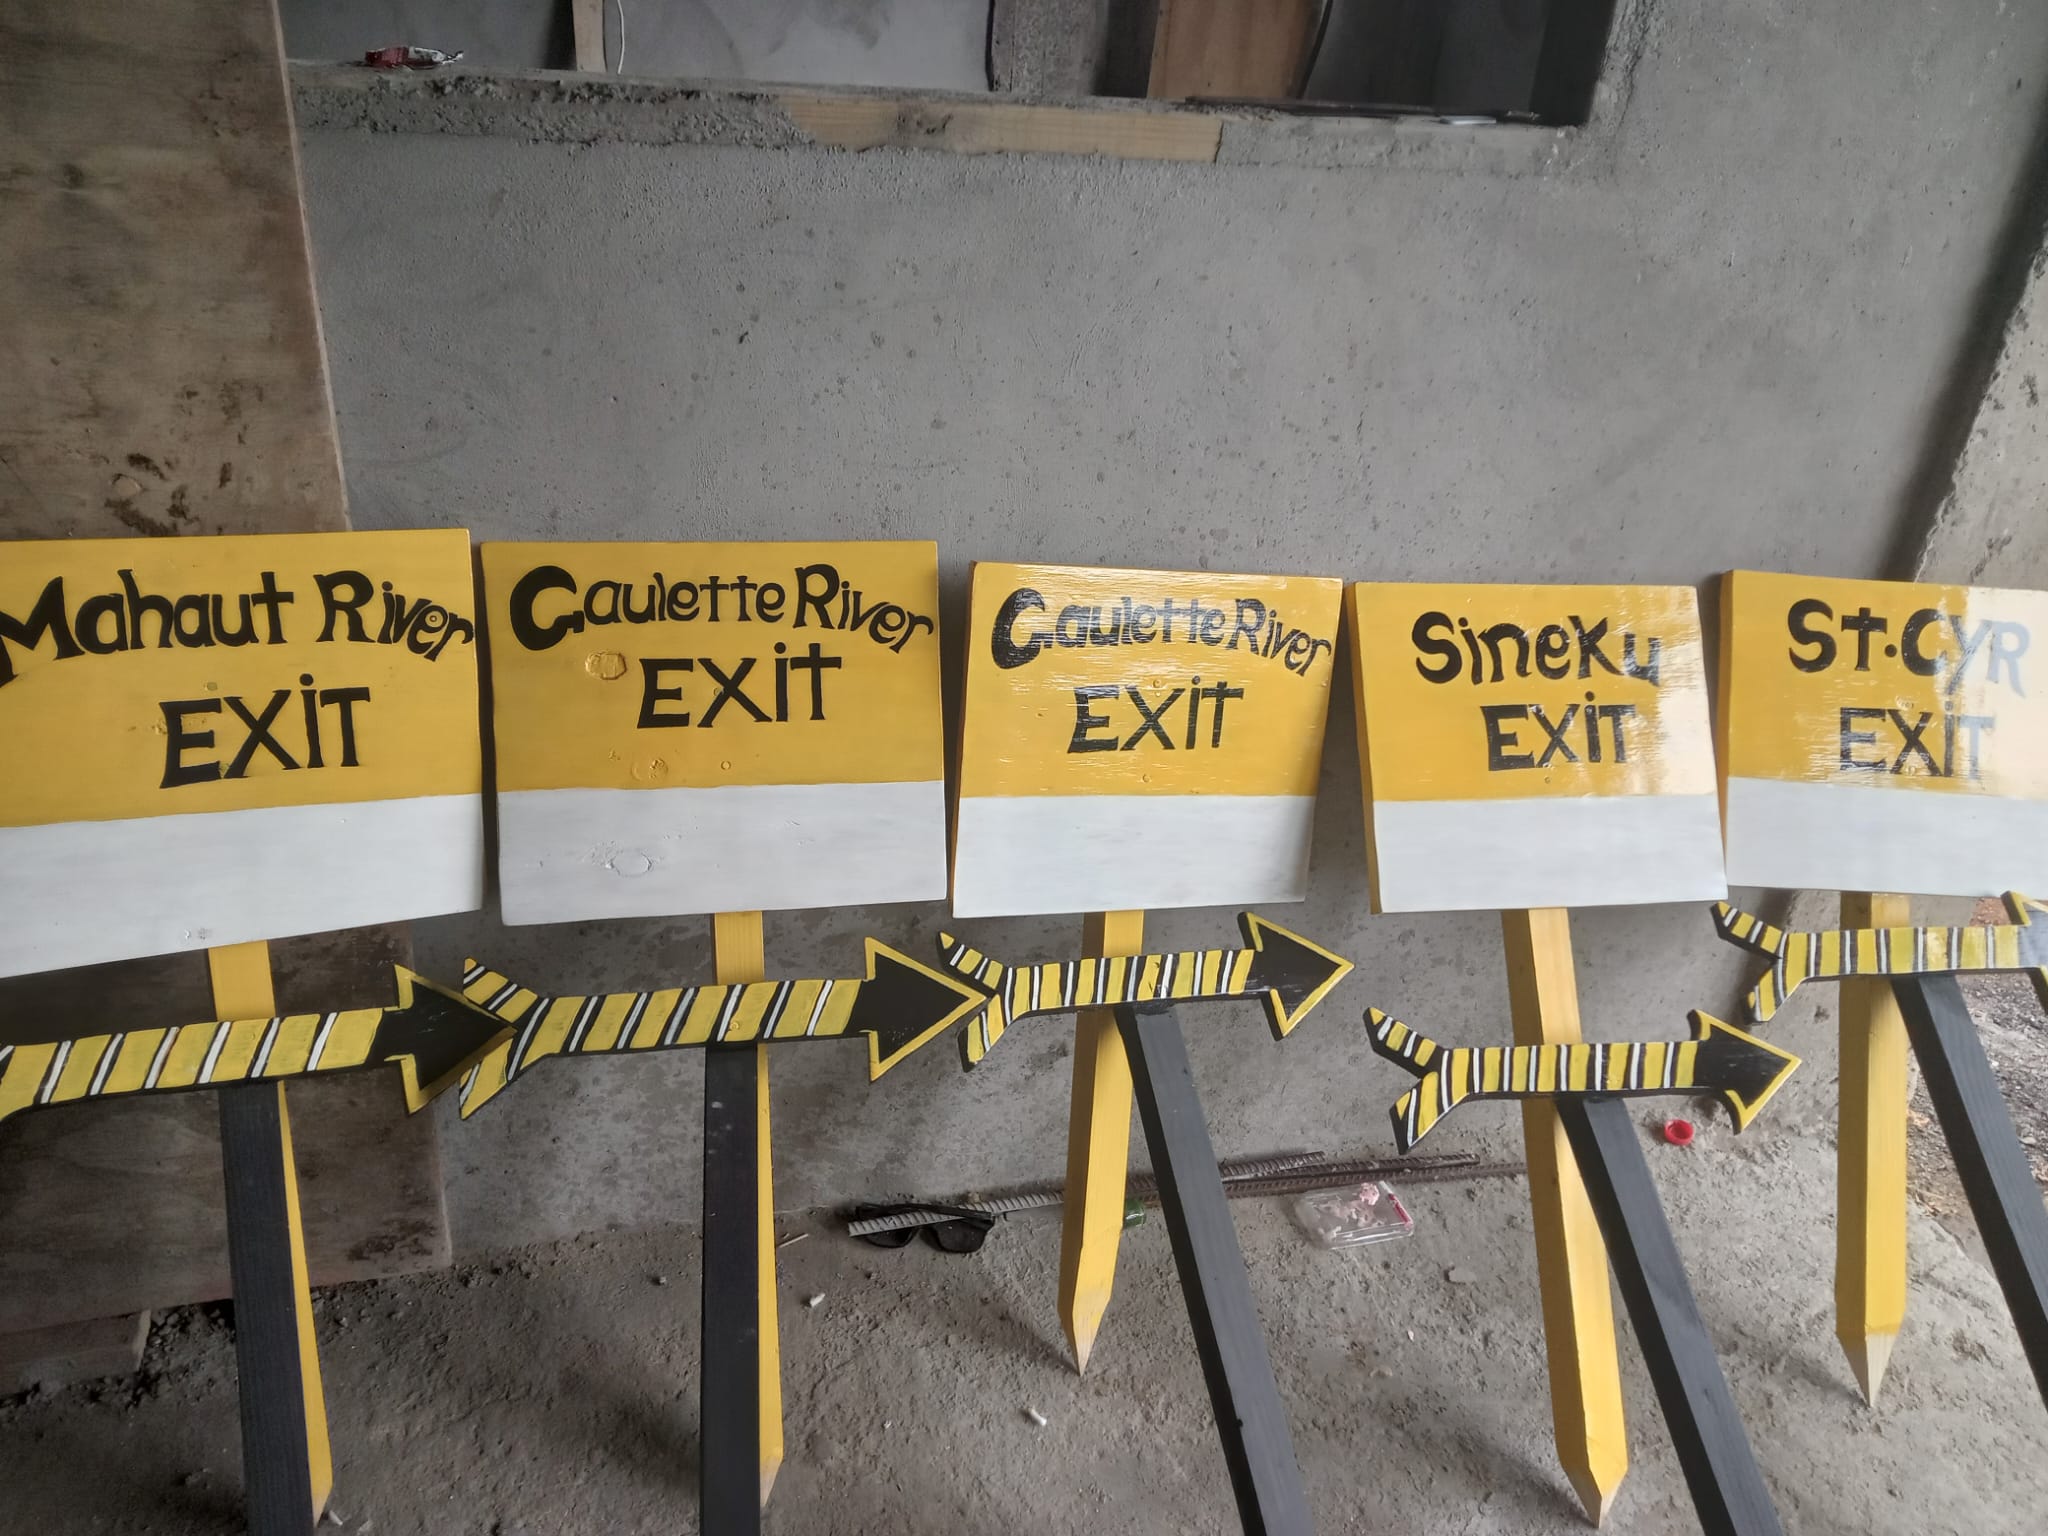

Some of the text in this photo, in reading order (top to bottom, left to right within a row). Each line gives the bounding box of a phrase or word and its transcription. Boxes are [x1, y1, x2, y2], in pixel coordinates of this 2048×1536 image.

[314, 570, 475, 662] River
[509, 563, 934, 653] Gaulette River
[1225, 598, 1332, 676] River
